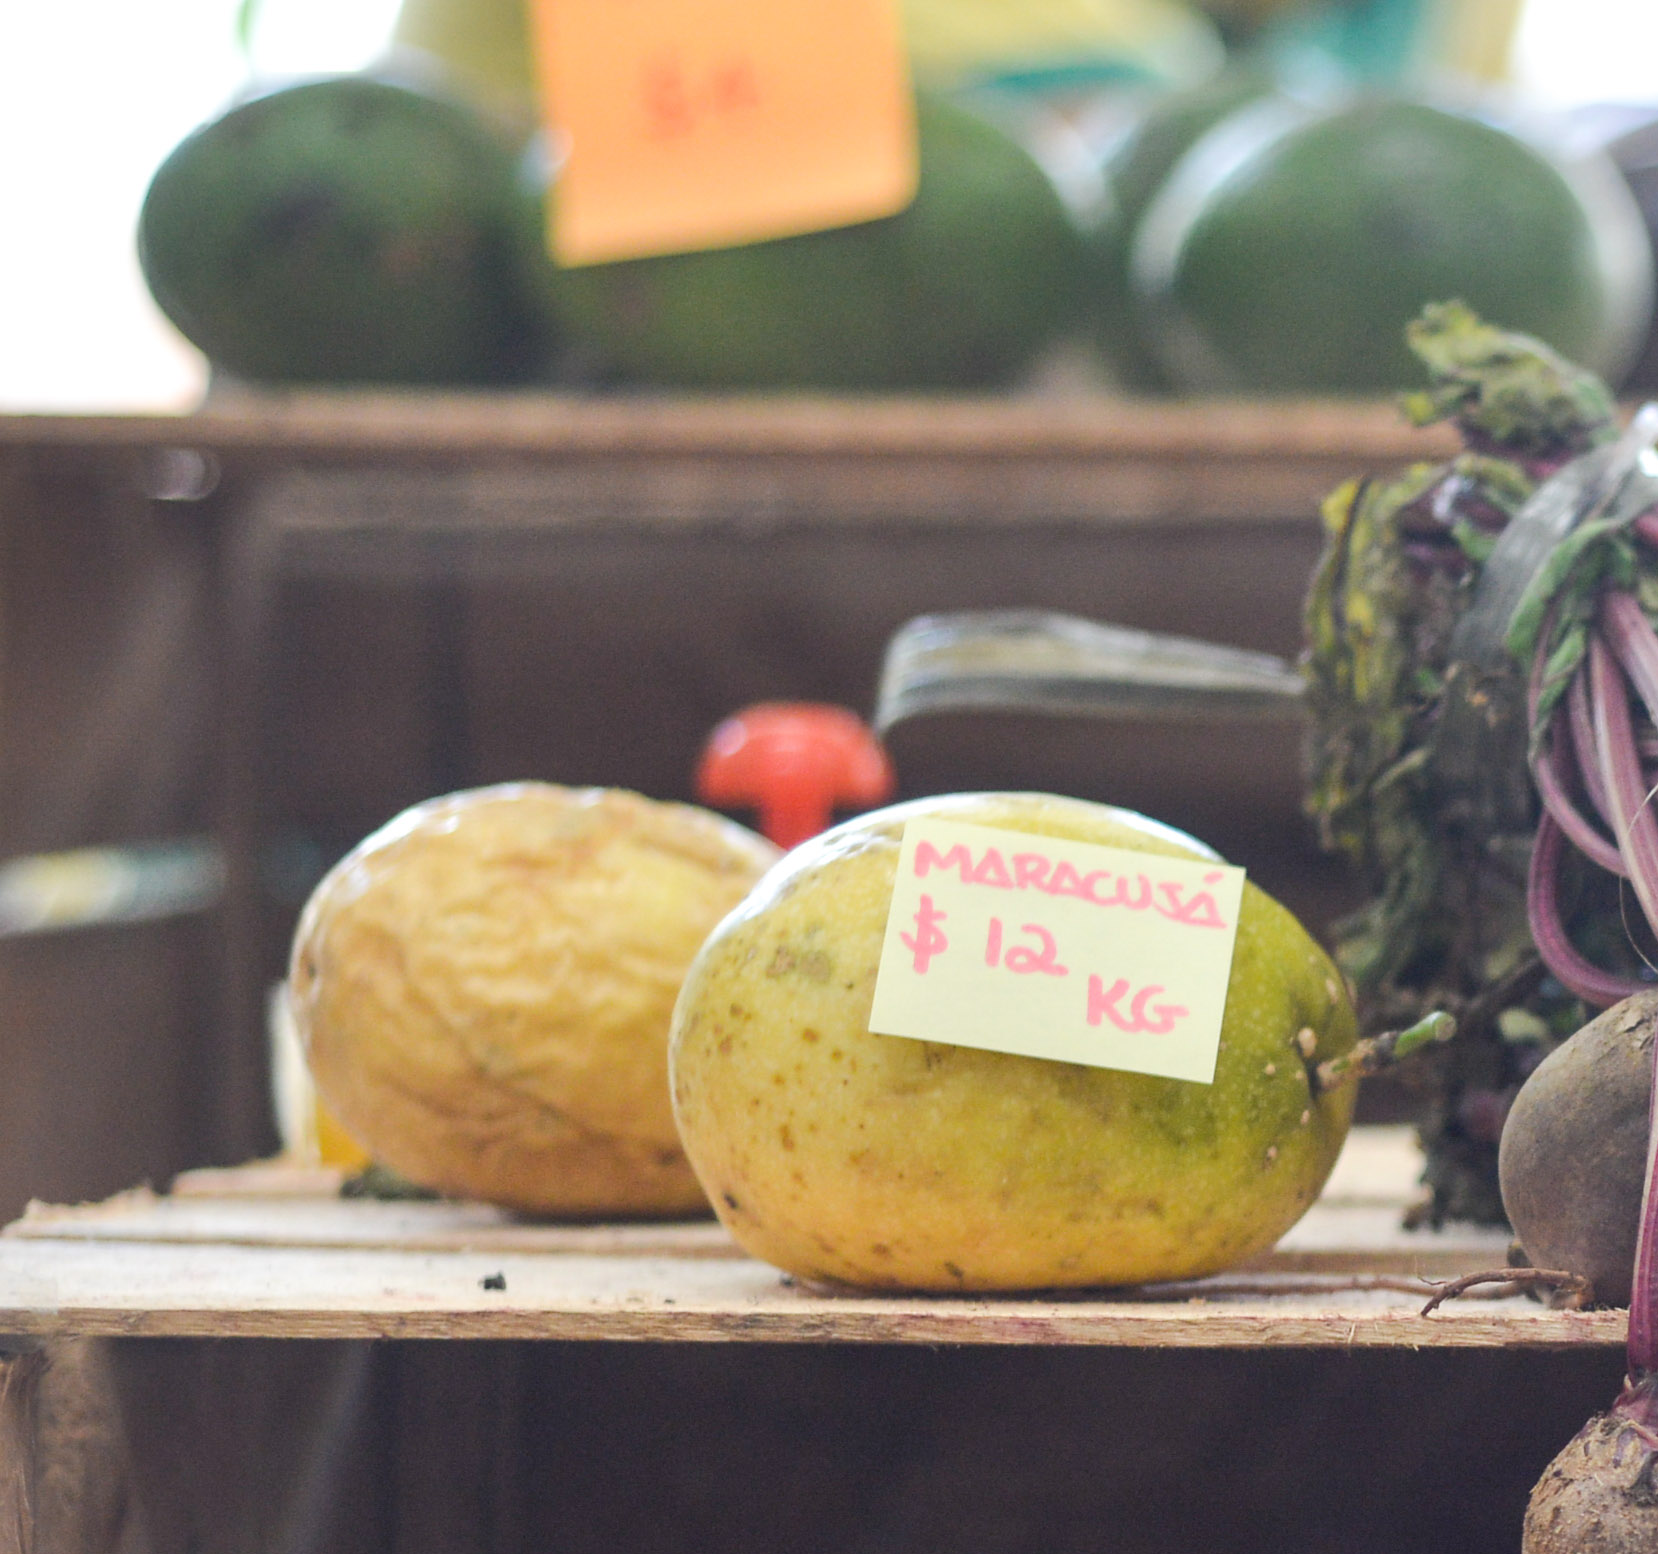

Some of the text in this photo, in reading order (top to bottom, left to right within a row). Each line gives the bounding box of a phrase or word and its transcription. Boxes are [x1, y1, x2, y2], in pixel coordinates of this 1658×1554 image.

[914, 840, 1227, 929] MARACUJÁ
[900, 893, 1069, 976] $ 12
[1087, 974, 1189, 1034] KG
